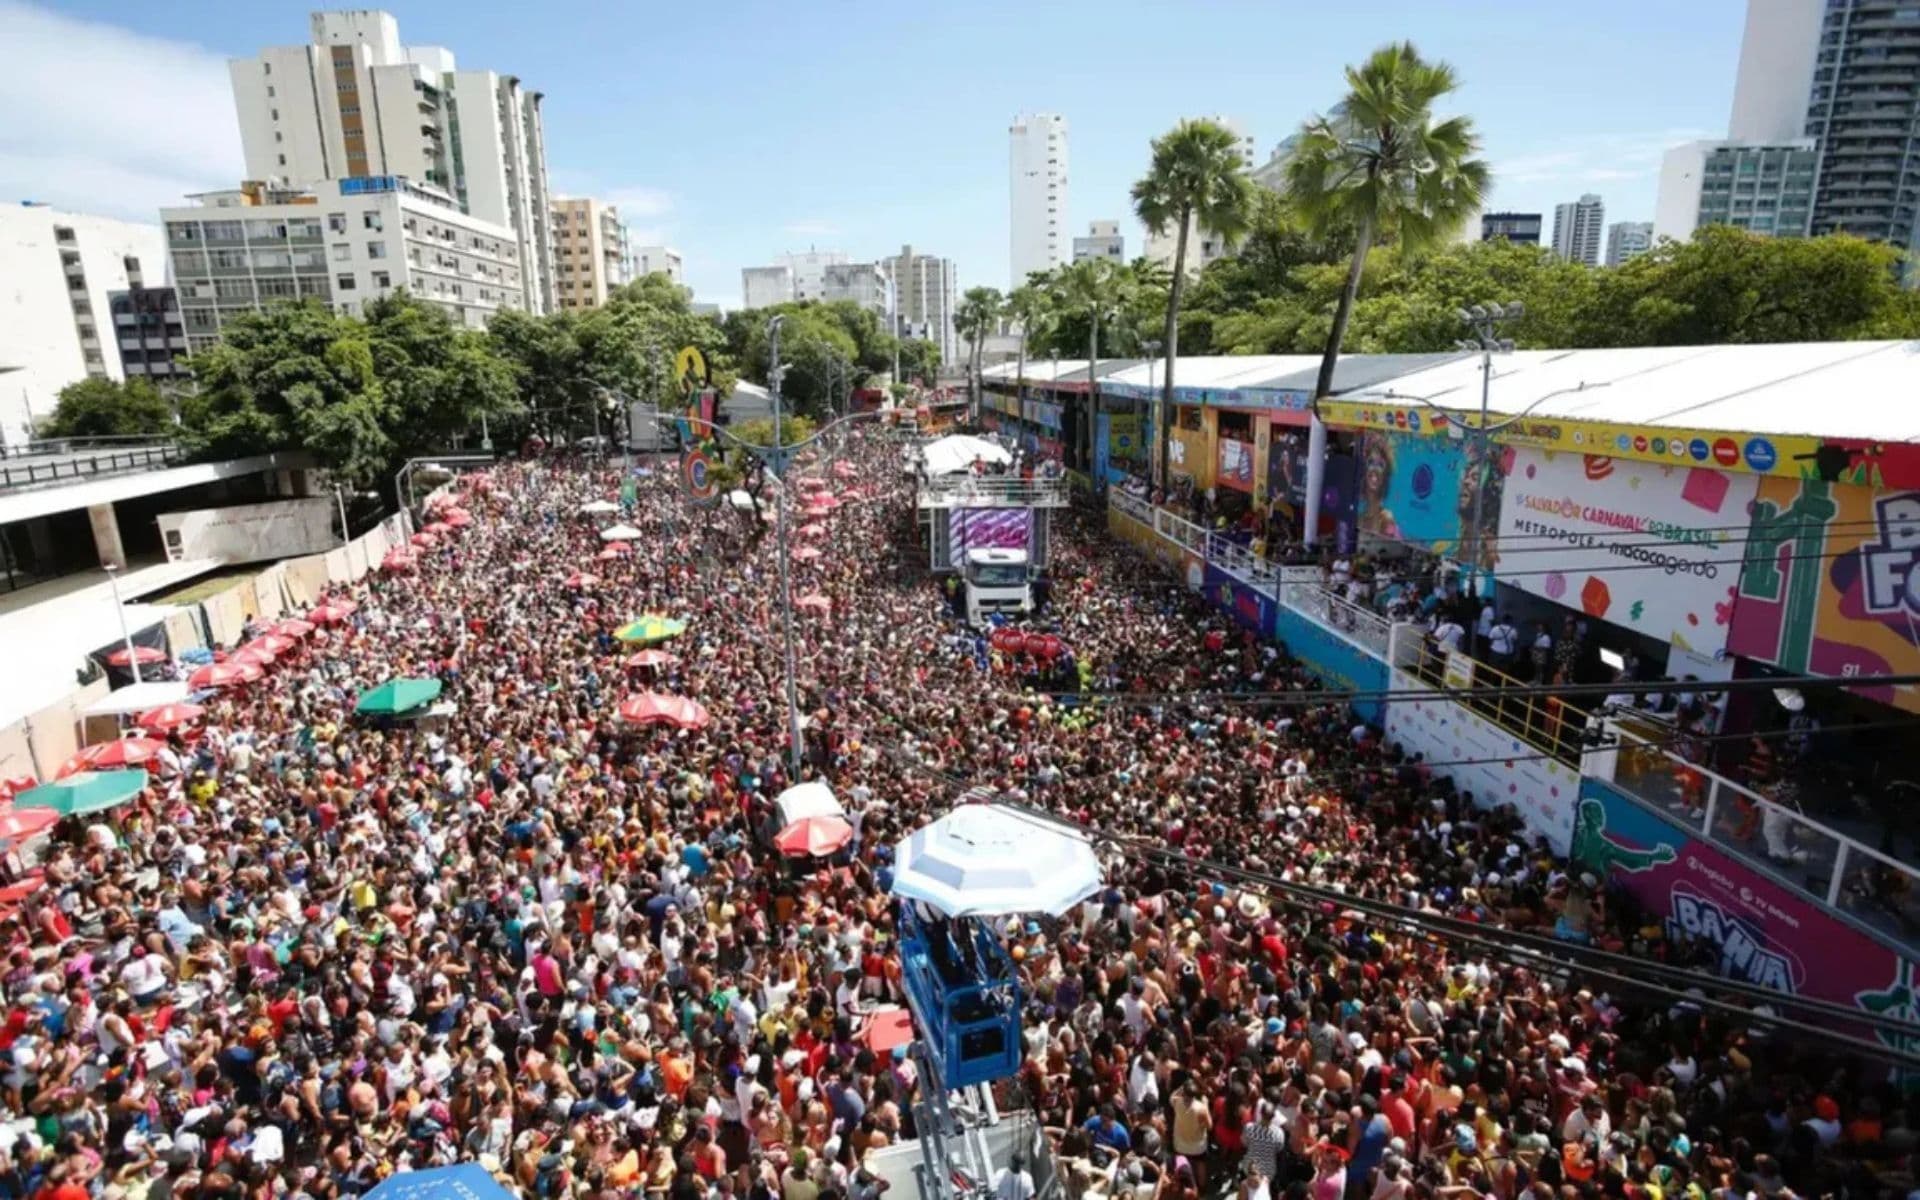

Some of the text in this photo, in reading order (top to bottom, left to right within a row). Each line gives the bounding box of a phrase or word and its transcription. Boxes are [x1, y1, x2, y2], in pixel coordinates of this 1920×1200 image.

[1515, 518, 1594, 548] METROPOLE
[1582, 506, 1646, 534] CARNAVAL
[1664, 523, 1719, 550] BRASIL
